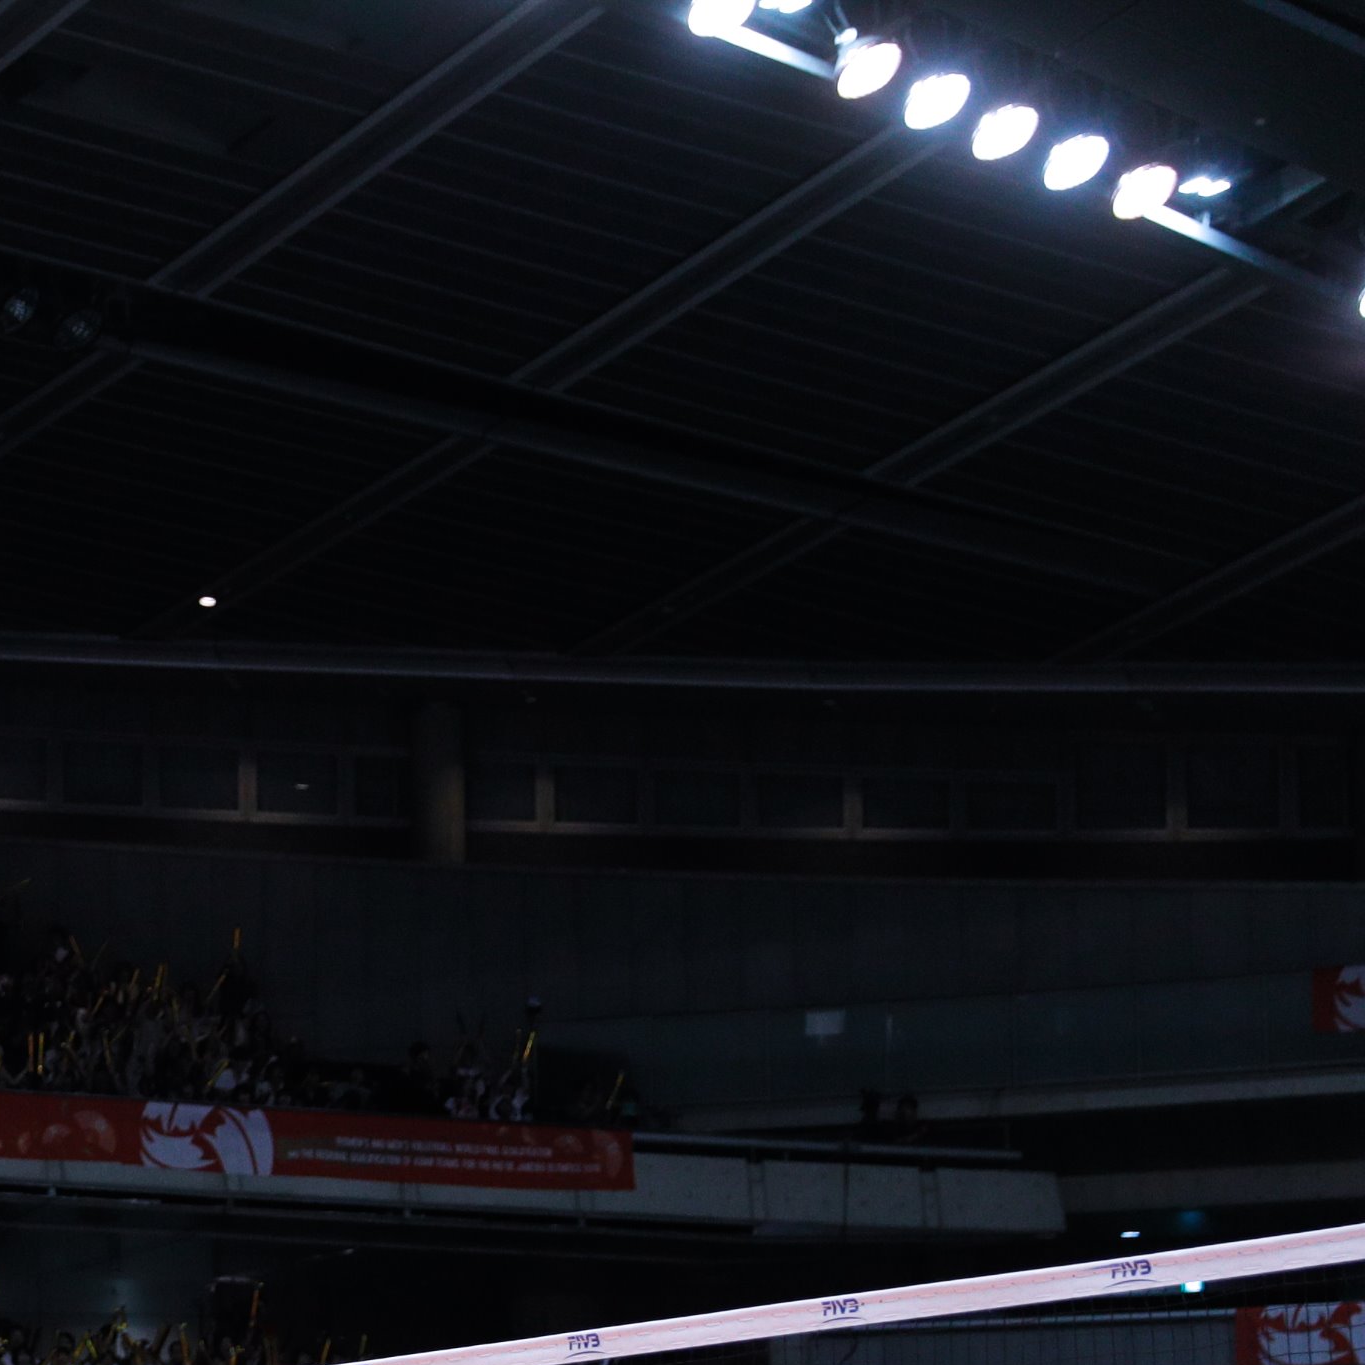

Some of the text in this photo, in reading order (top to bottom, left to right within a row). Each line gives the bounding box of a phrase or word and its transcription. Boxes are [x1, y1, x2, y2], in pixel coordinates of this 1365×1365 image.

[1111, 1259, 1152, 1279] FIVB
[822, 1298, 859, 1316] FIVB
[567, 1333, 601, 1351] FIVB
